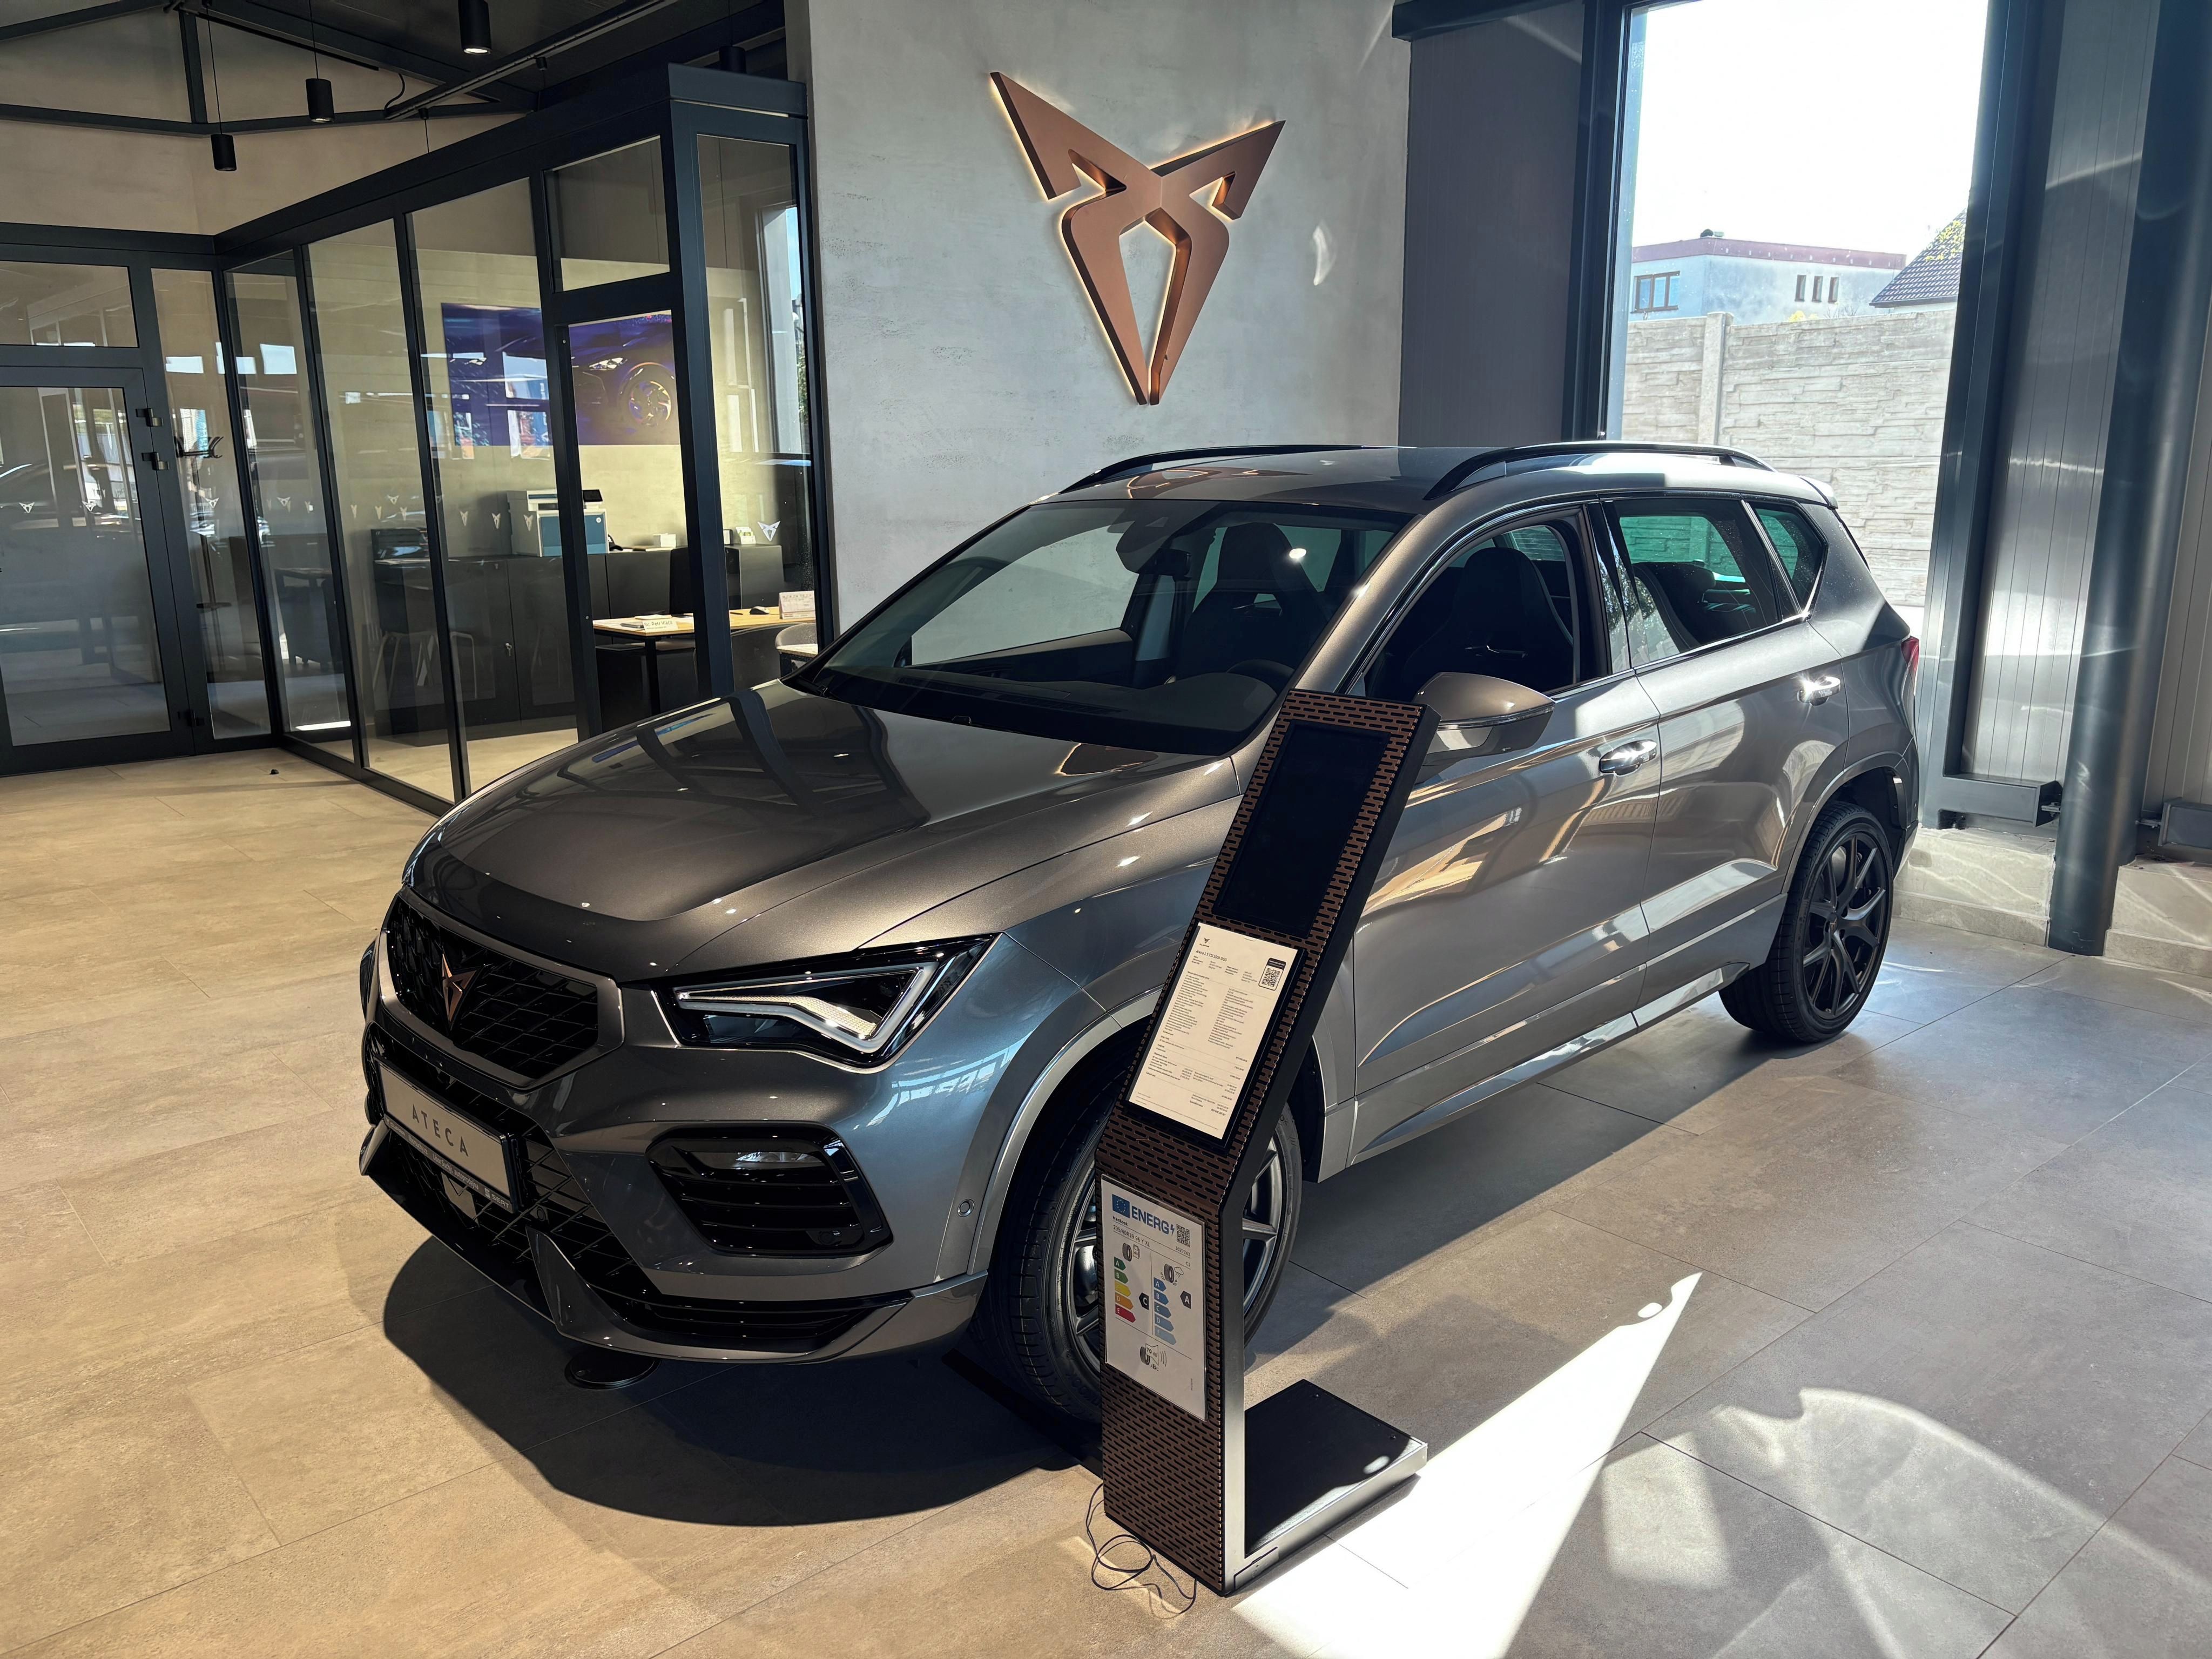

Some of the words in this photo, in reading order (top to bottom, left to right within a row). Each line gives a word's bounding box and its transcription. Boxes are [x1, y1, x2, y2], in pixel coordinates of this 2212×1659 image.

[412, 1104, 469, 1157] ATECA
[491, 1194, 509, 1208] SEAT
[1132, 1205, 1169, 1235] ENERG
[1143, 1297, 1148, 1305] C
[1184, 1296, 1190, 1305] A
